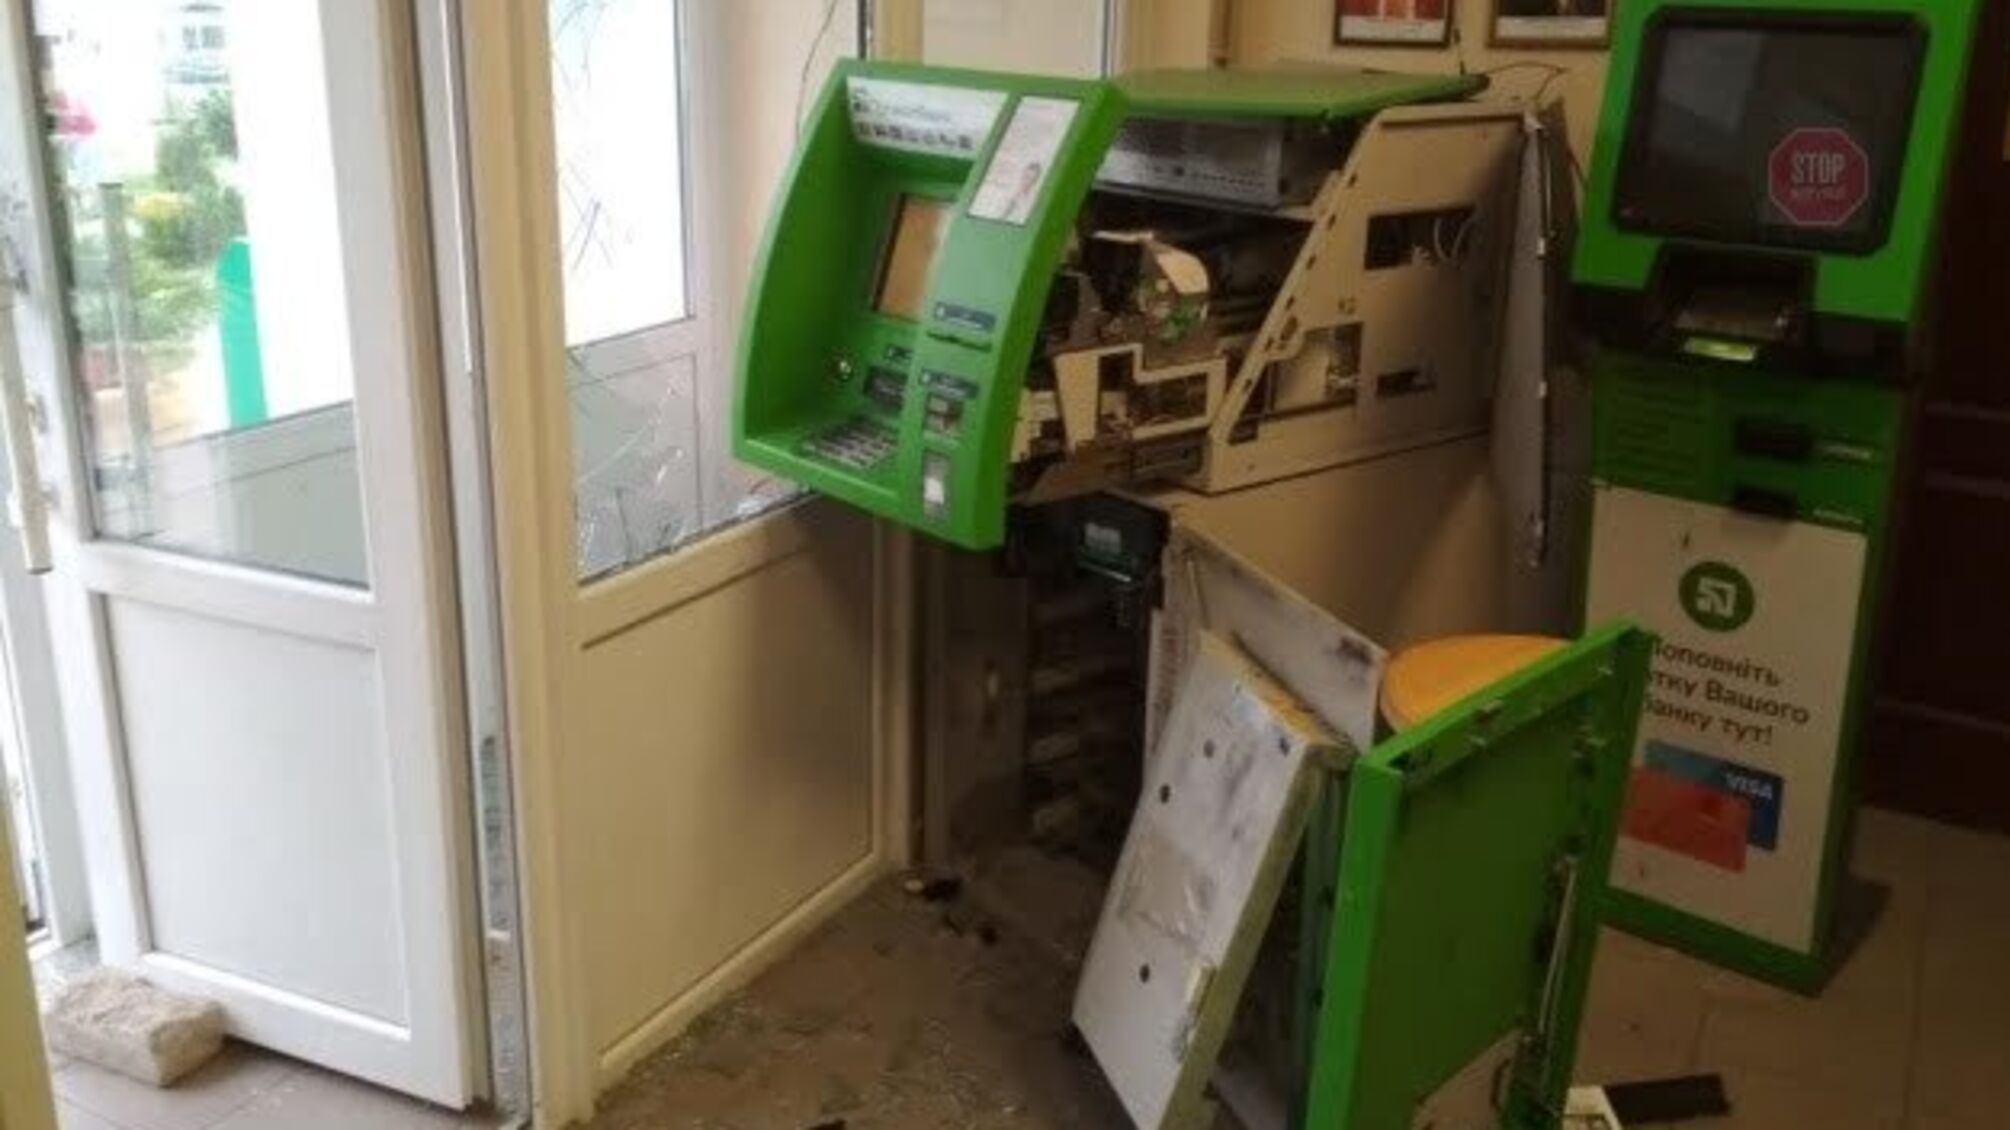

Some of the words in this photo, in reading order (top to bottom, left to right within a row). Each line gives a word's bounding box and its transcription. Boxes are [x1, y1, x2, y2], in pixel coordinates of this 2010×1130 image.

[1791, 151, 1846, 185] STOP
[1706, 679, 1811, 724] Вашого
[1718, 716, 1774, 745] тут!
[1725, 772, 1773, 800] VISA
